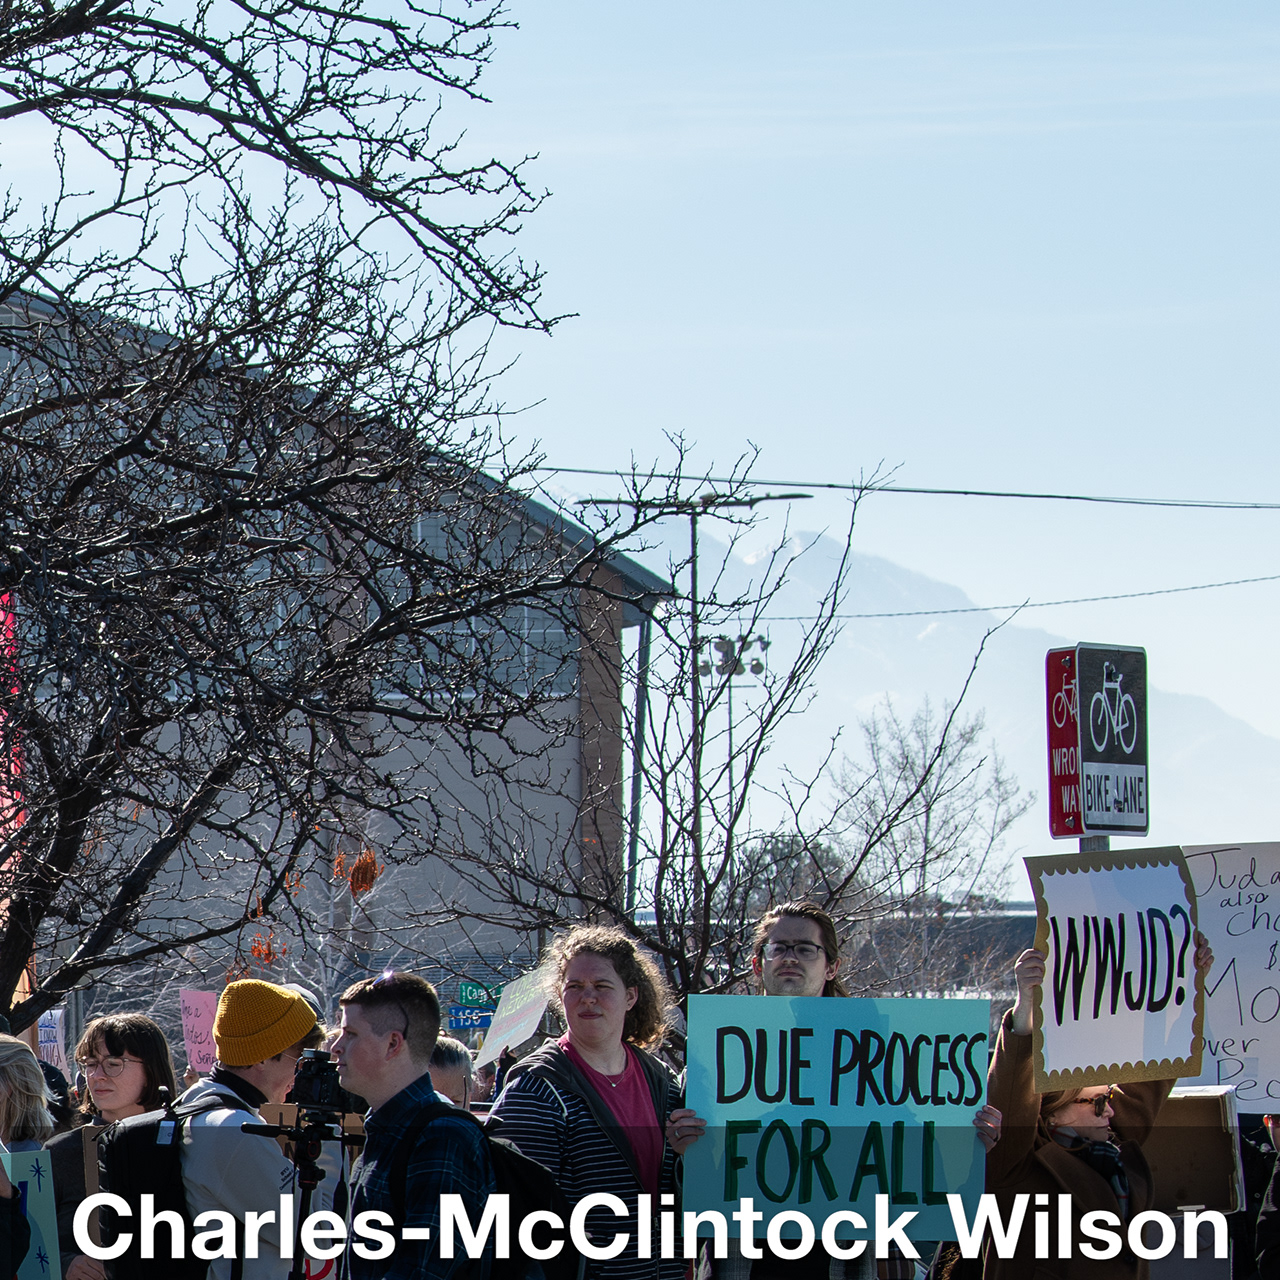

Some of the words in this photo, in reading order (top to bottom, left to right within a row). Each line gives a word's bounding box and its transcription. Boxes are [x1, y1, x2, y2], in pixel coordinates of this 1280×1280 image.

[1085, 774, 1110, 812] BIKE
[1113, 776, 1144, 814] LANE
[1220, 891, 1269, 907] also
[1050, 904, 1191, 1026] WWJD?
[716, 1026, 815, 1105] DUE
[829, 1028, 987, 1107] PROCESS
[1201, 1037, 1260, 1057] ver
[723, 1119, 839, 1204] FOR
[849, 1120, 948, 1206] ALL
